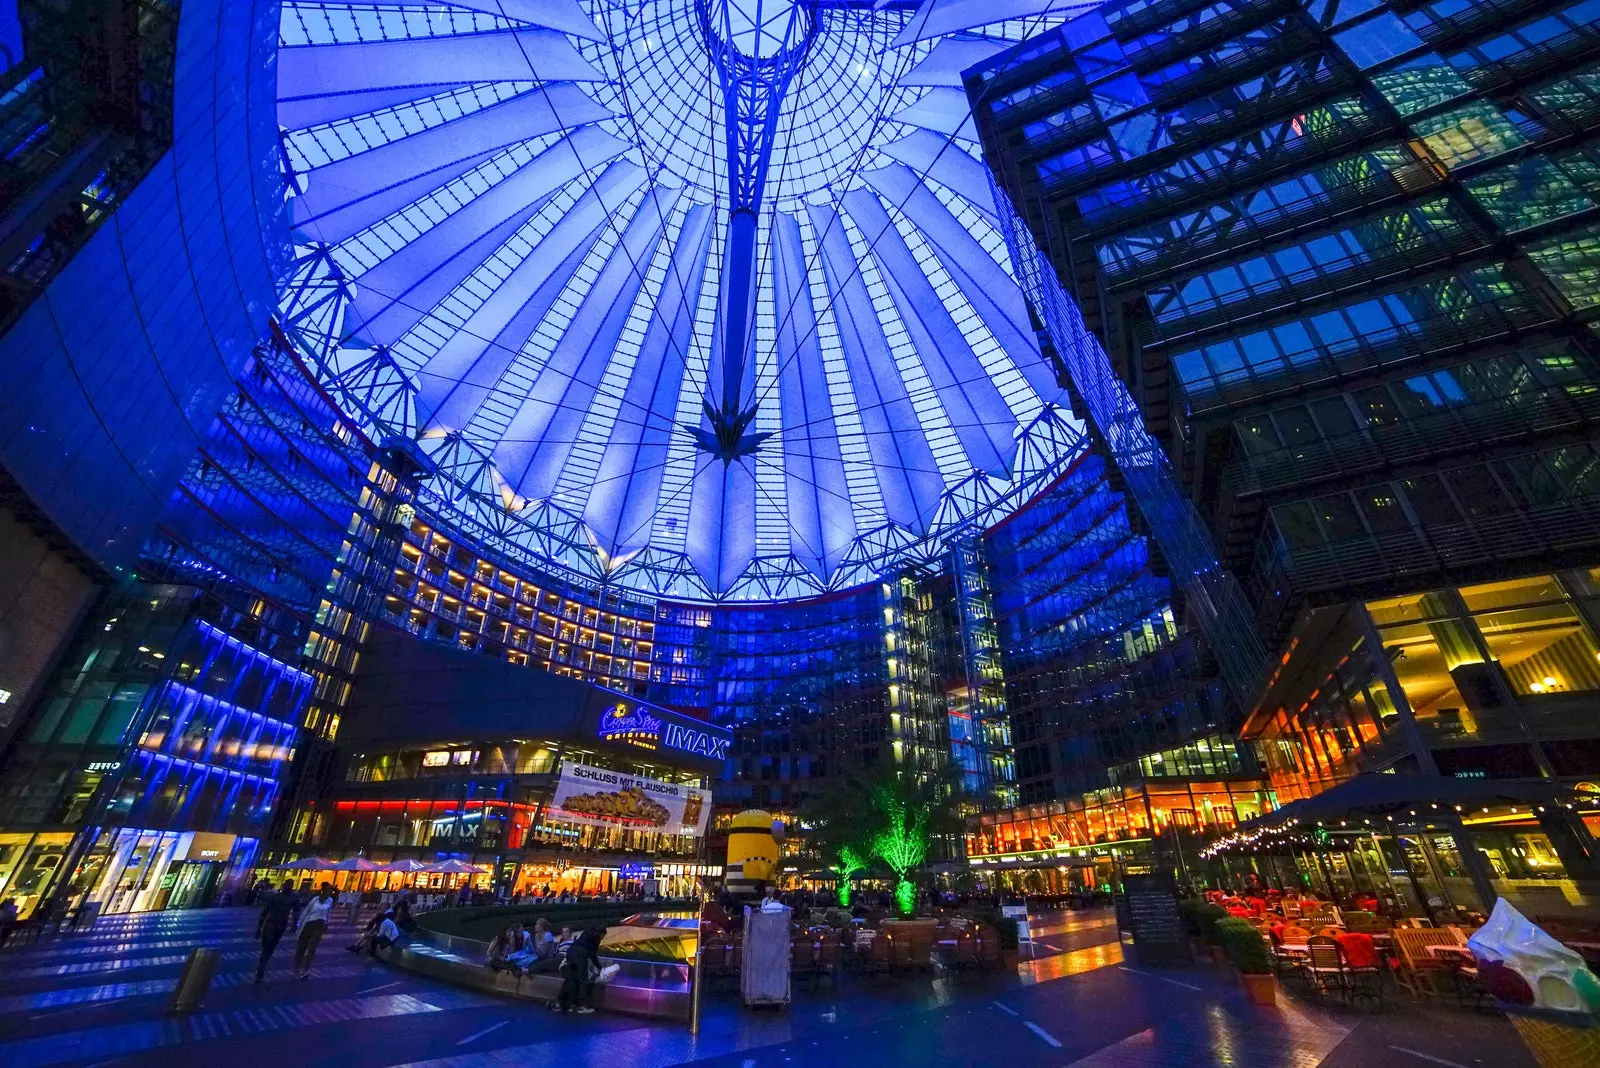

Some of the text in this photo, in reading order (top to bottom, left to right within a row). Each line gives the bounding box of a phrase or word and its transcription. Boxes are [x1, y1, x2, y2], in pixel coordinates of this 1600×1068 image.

[664, 723, 727, 760] IMAX
[573, 767, 679, 796] SCHLUSS MIT FLAUSCHIG
